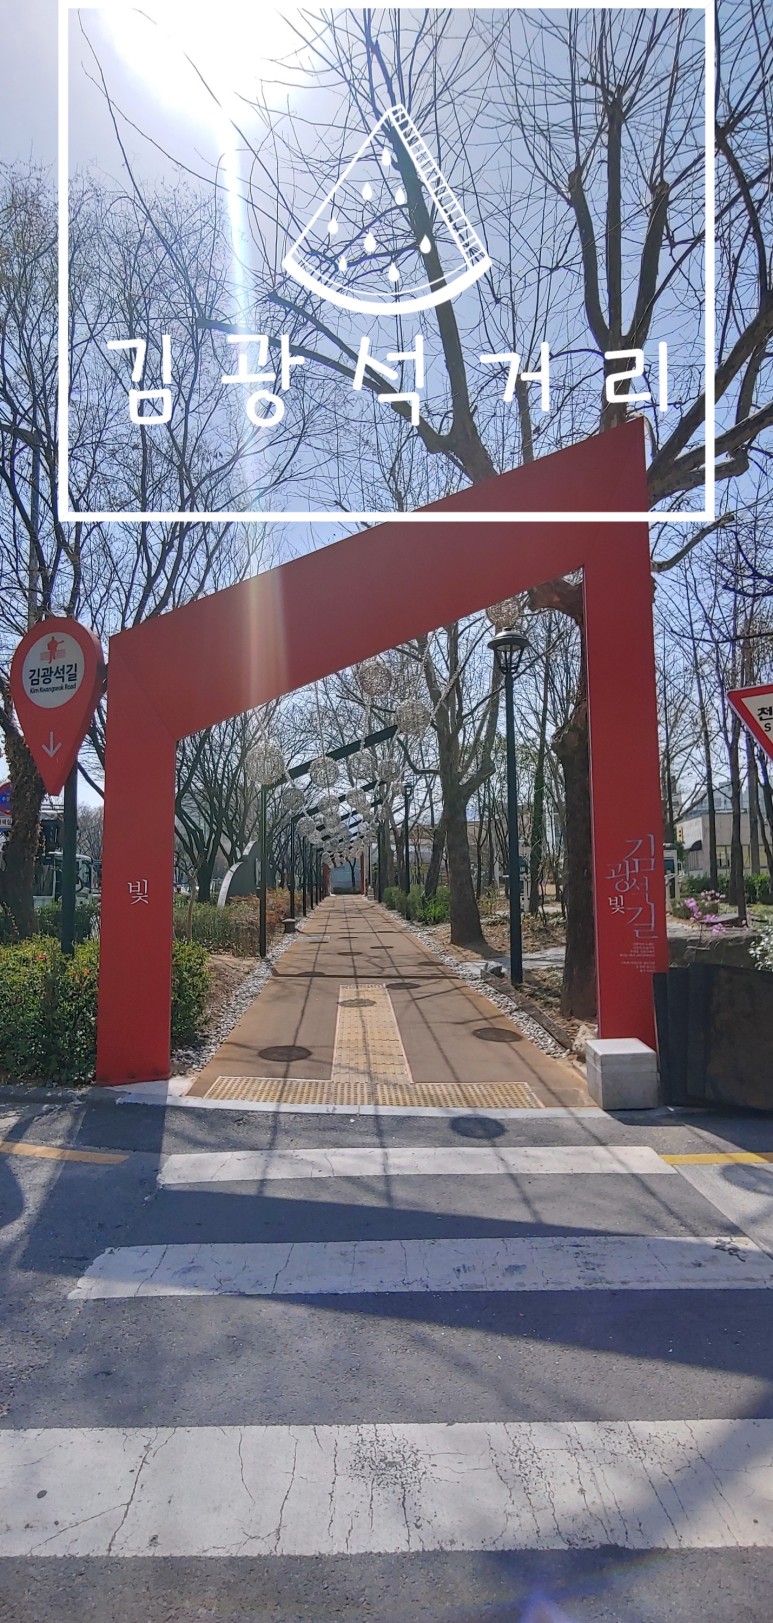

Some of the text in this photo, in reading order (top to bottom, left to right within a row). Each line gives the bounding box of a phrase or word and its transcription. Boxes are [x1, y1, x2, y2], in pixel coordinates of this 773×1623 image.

[29, 663, 77, 686] 김광석길
[127, 879, 149, 905] 빛
[608, 894, 625, 914] 빛
